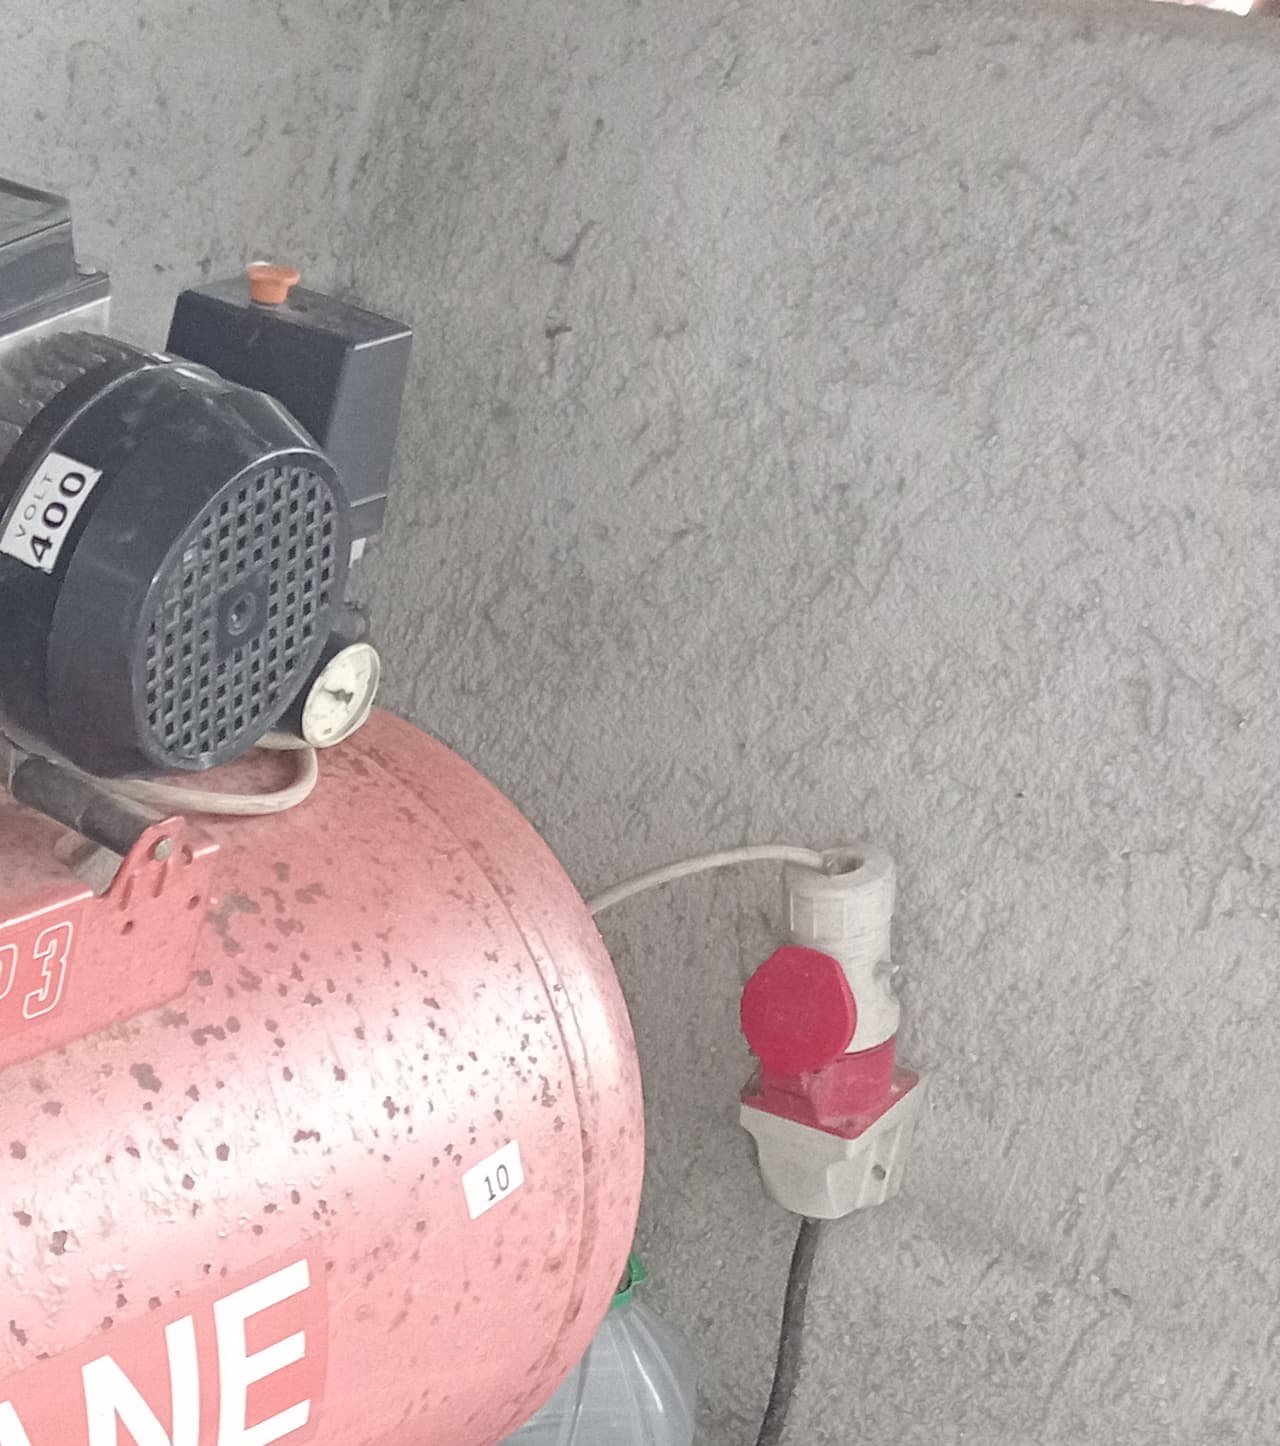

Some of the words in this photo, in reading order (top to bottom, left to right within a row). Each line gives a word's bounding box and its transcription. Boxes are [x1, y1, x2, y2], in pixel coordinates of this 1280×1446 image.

[15, 473, 53, 538] VOLT
[30, 472, 86, 562] 400
[22, 921, 73, 1020] 3
[483, 1164, 510, 1201] 10
